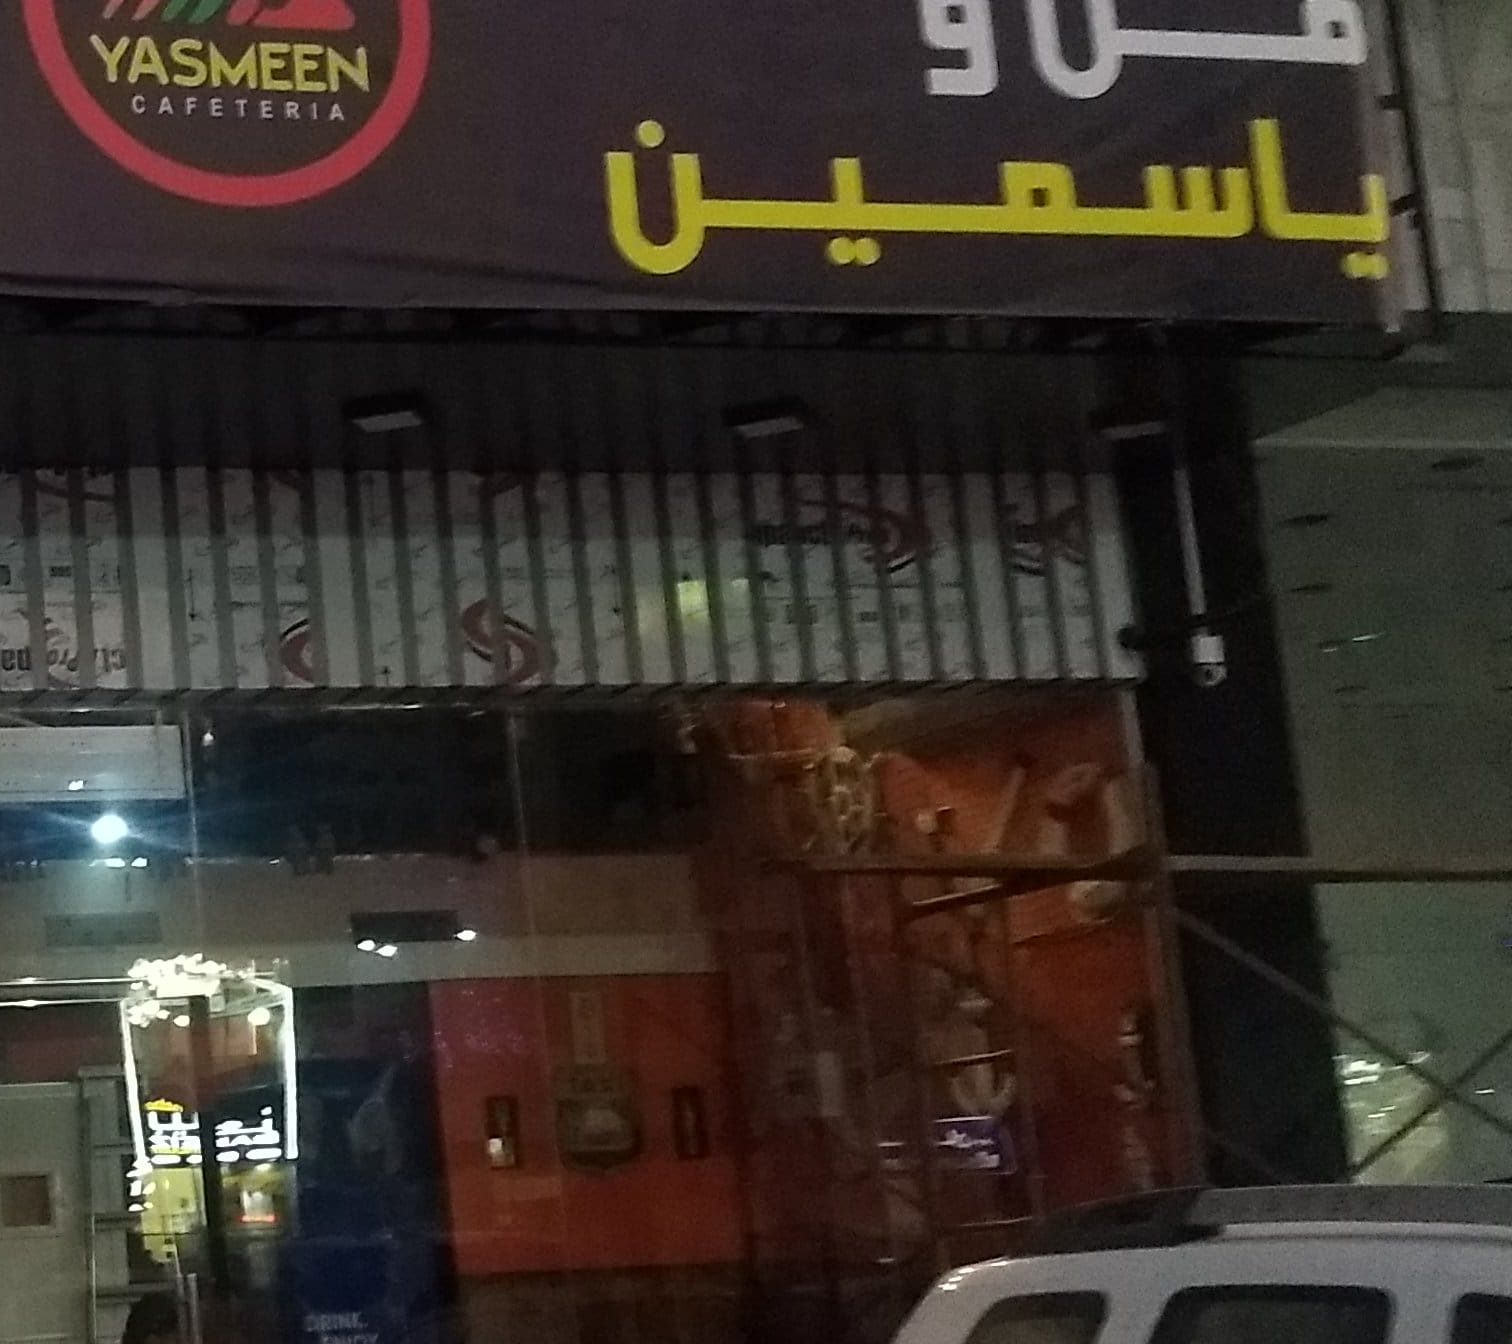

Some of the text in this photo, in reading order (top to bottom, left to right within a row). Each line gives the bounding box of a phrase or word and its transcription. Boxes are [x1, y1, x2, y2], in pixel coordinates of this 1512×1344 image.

[90, 33, 370, 93] YASMEEN
[131, 94, 345, 121] CAFETERIA
[604, 116, 1391, 279] ياسمين
